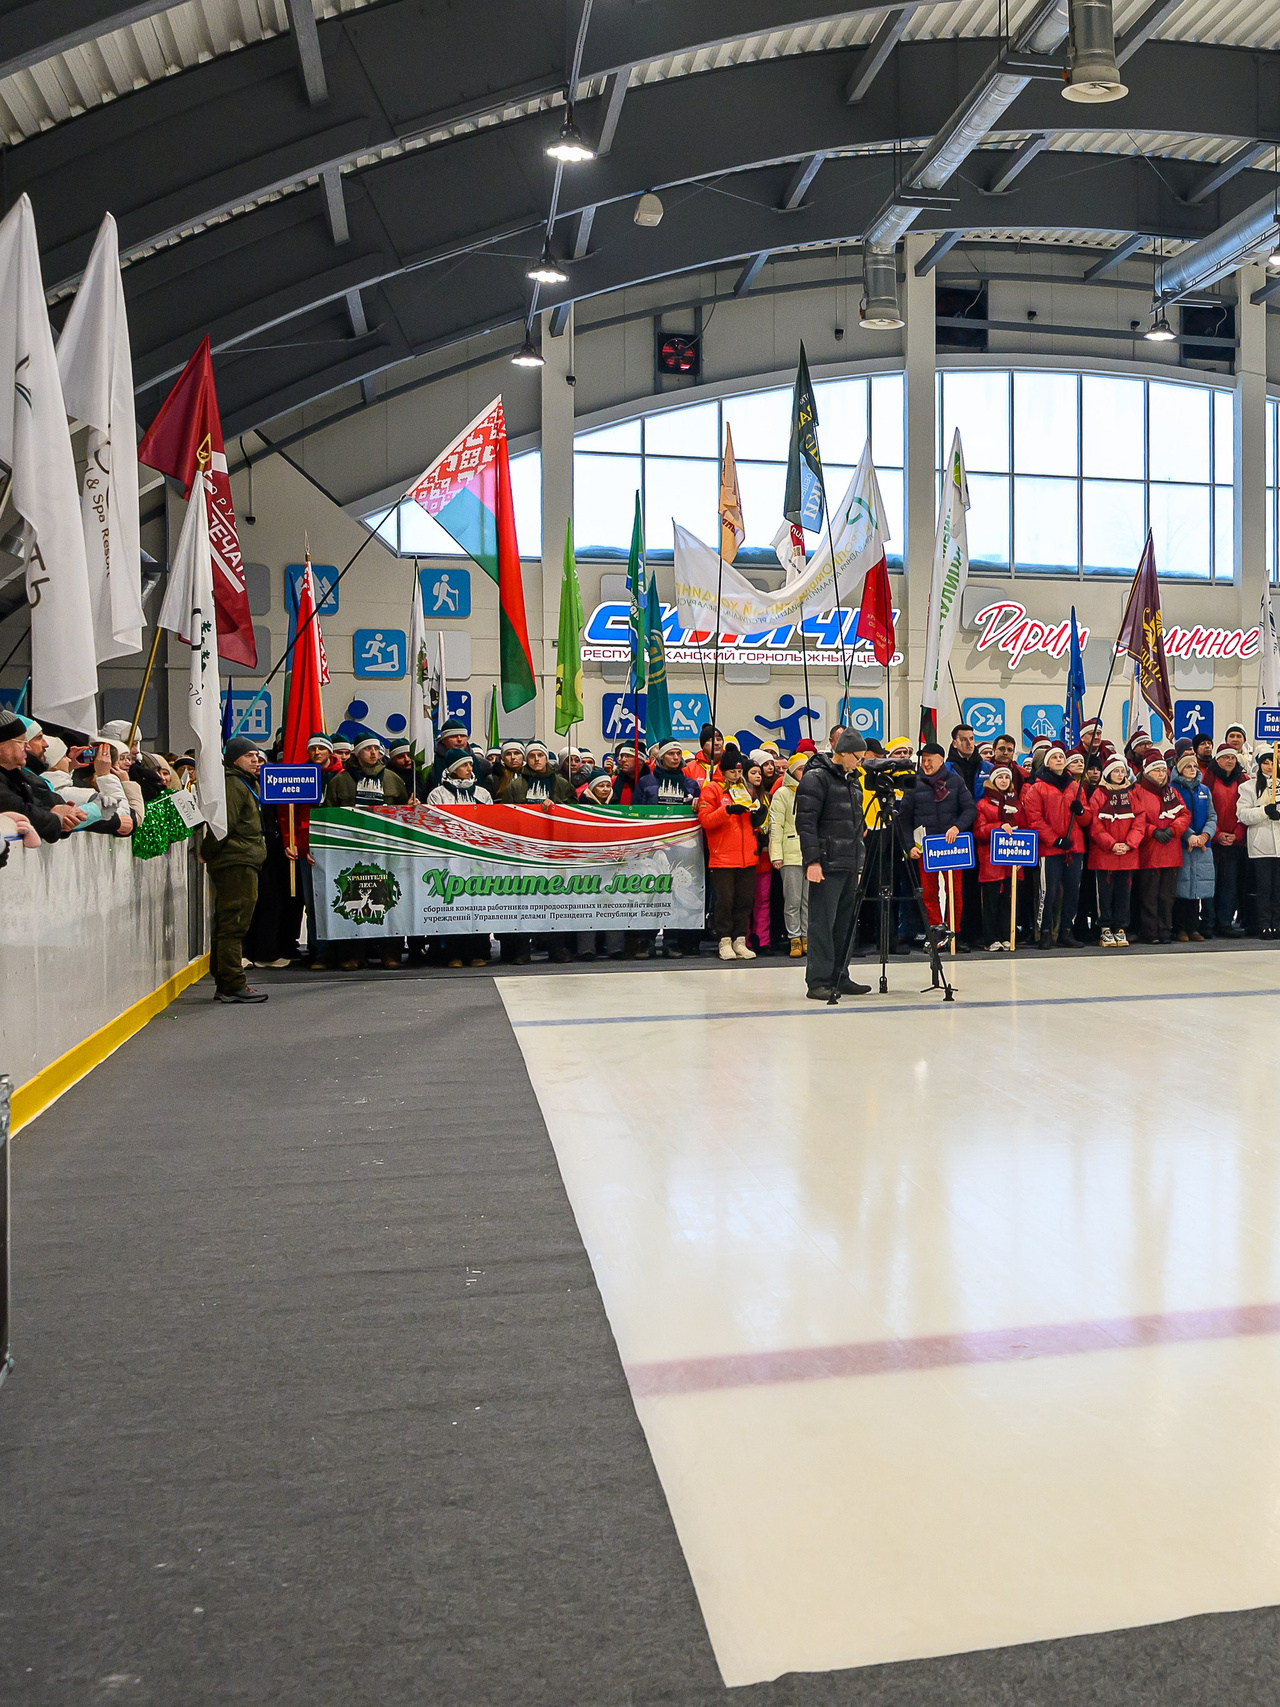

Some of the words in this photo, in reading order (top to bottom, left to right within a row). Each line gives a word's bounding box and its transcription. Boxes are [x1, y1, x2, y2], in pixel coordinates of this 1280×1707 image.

[92, 494, 105, 522] Spa
[976, 603, 1087, 667] Дарим
[1114, 625, 1259, 657] личное
[583, 650, 735, 661] РЕСПУКАНСКИЙ
[857, 654, 901, 664] ЦЕР
[986, 714, 1003, 726] 24
[267, 774, 315, 786] Хранители
[929, 846, 969, 859] Агрохолдинг
[422, 868, 601, 904] Хранители
[604, 873, 673, 895] леса
[423, 904, 454, 913] сборная
[455, 904, 487, 912] команда
[487, 903, 529, 913] работников
[529, 902, 597, 912] природоохранных
[602, 901, 672, 910] лесохозяйственных
[423, 913, 471, 923] учреждений
[474, 912, 518, 922] Управления
[520, 913, 547, 921] делами
[549, 912, 593, 920] Президента
[595, 911, 638, 920] Республики
[640, 910, 672, 919] Беларусь
